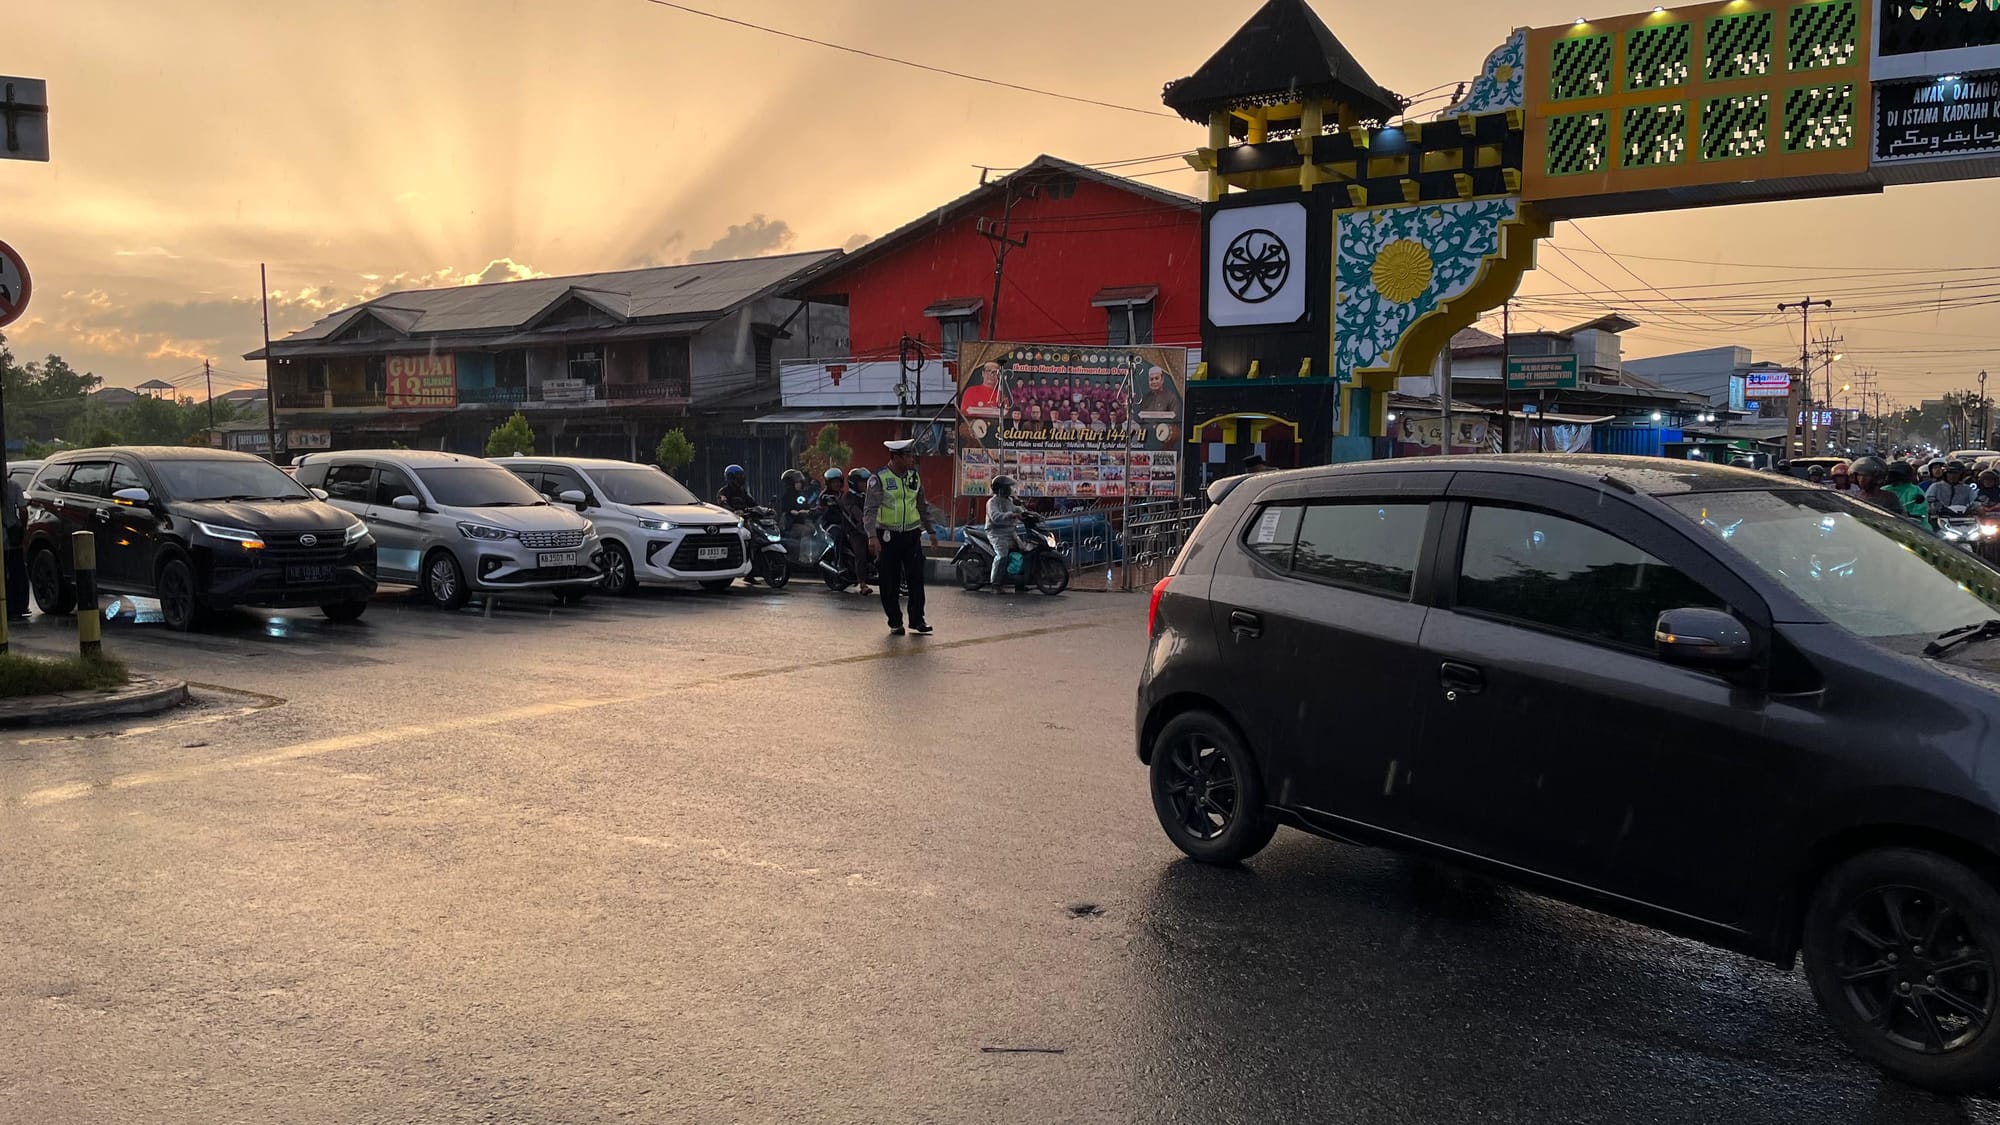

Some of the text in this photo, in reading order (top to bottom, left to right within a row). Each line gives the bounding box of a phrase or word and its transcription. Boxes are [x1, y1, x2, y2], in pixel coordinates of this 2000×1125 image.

[1913, 80, 1999, 104] AWAK DATANG
[1887, 110, 1899, 127] DI
[1902, 106, 1939, 125] ISTANA
[1943, 102, 1989, 123] KADRIAH
[389, 356, 452, 377] GULAI
[390, 377, 454, 406] 13 RIBU
[995, 427, 1047, 441] Selamat
[1049, 428, 1076, 441] Idul
[1079, 428, 1104, 441] Fitri
[1136, 428, 1147, 441] H
